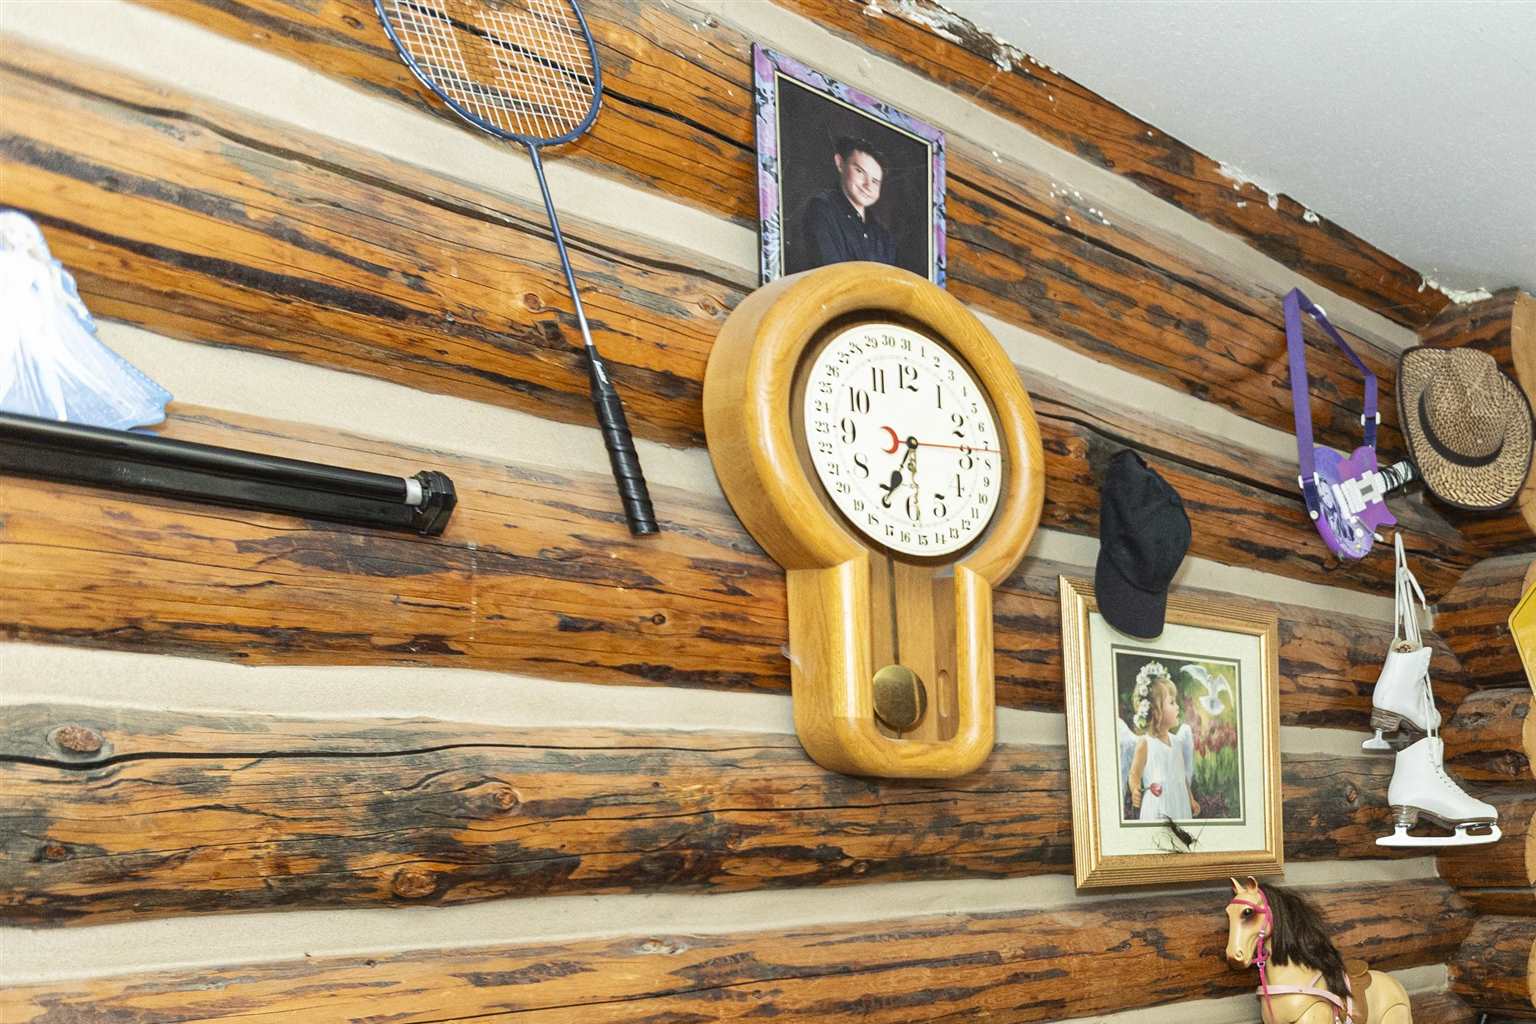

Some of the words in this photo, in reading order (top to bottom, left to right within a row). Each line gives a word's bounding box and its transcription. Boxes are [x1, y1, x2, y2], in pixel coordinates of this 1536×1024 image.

[872, 367, 885, 394] 11
[899, 364, 918, 392] 12
[850, 387, 870, 413] 10
[935, 384, 943, 411] 1
[841, 418, 856, 443] 9
[951, 413, 966, 439] 2
[854, 454, 869, 477] 8
[959, 444, 974, 470] 3
[933, 494, 946, 517] 5
